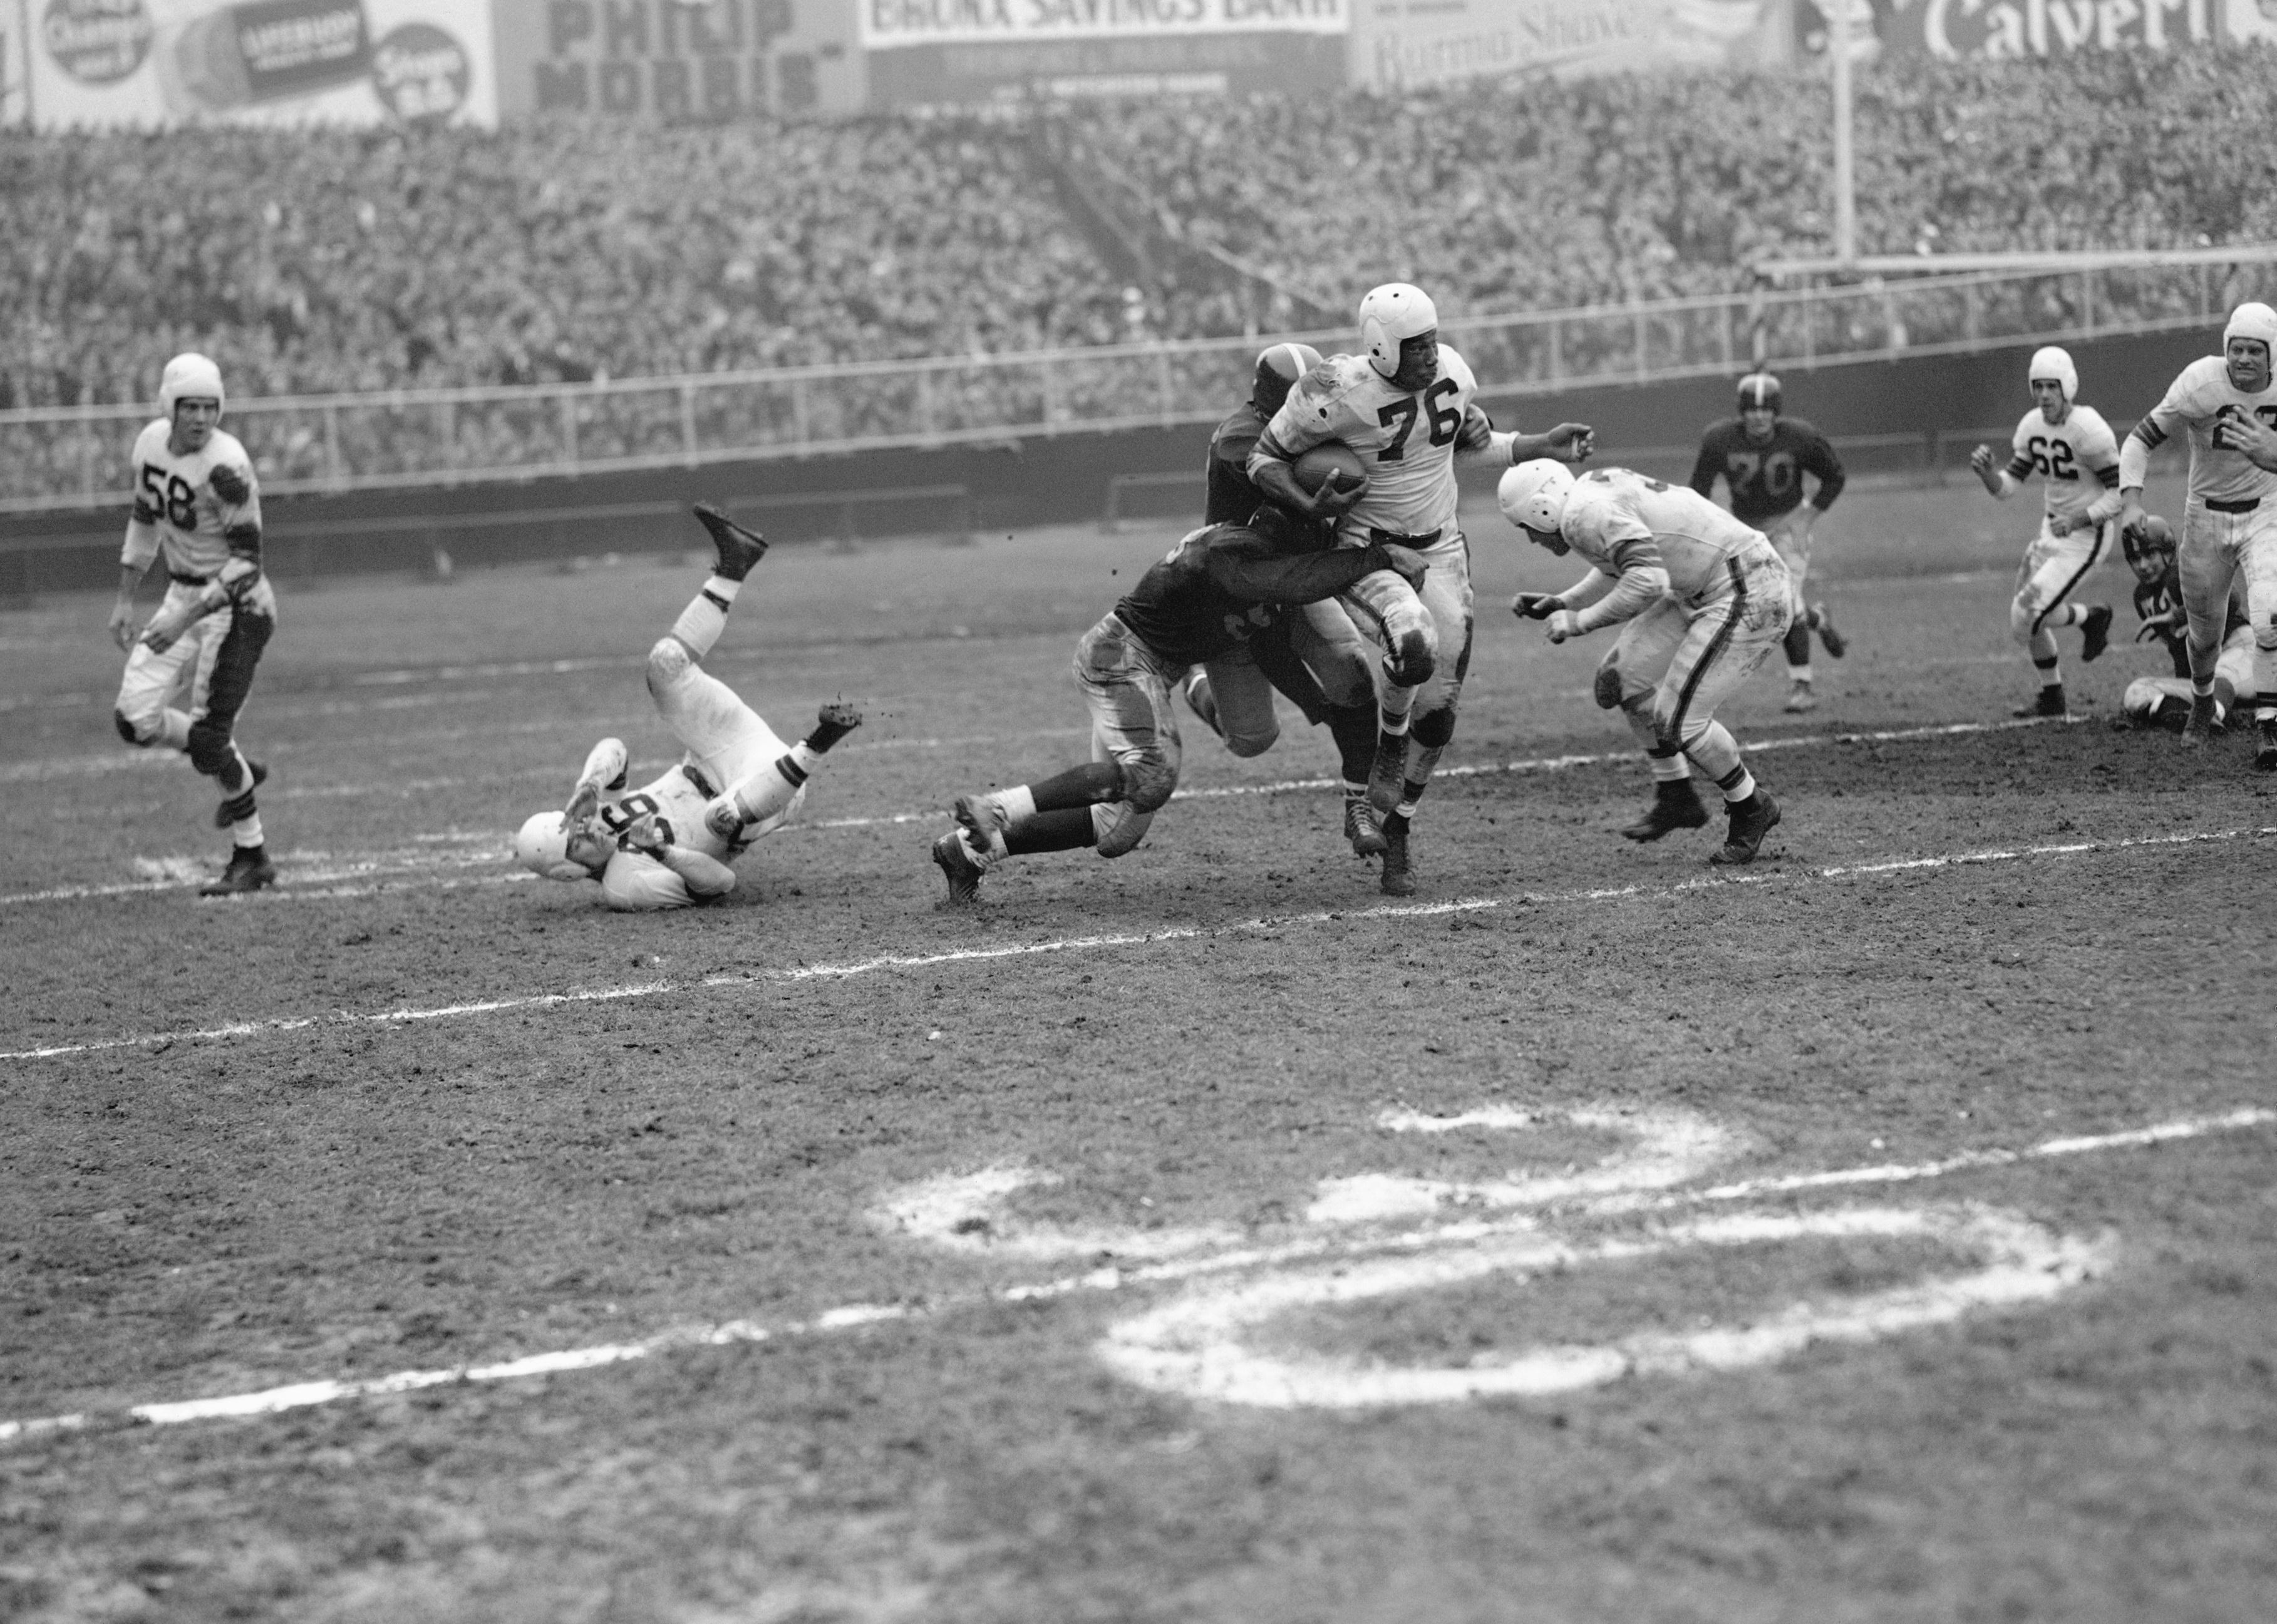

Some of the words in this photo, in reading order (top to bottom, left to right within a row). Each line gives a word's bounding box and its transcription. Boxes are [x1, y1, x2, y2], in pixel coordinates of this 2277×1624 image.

[546, 0, 794, 58] PHILIP
[534, 54, 817, 116] MORRIS
[1376, 377, 1462, 462] 76
[1727, 451, 1796, 497] 70
[2028, 436, 2079, 480] 62
[143, 462, 198, 532] 58
